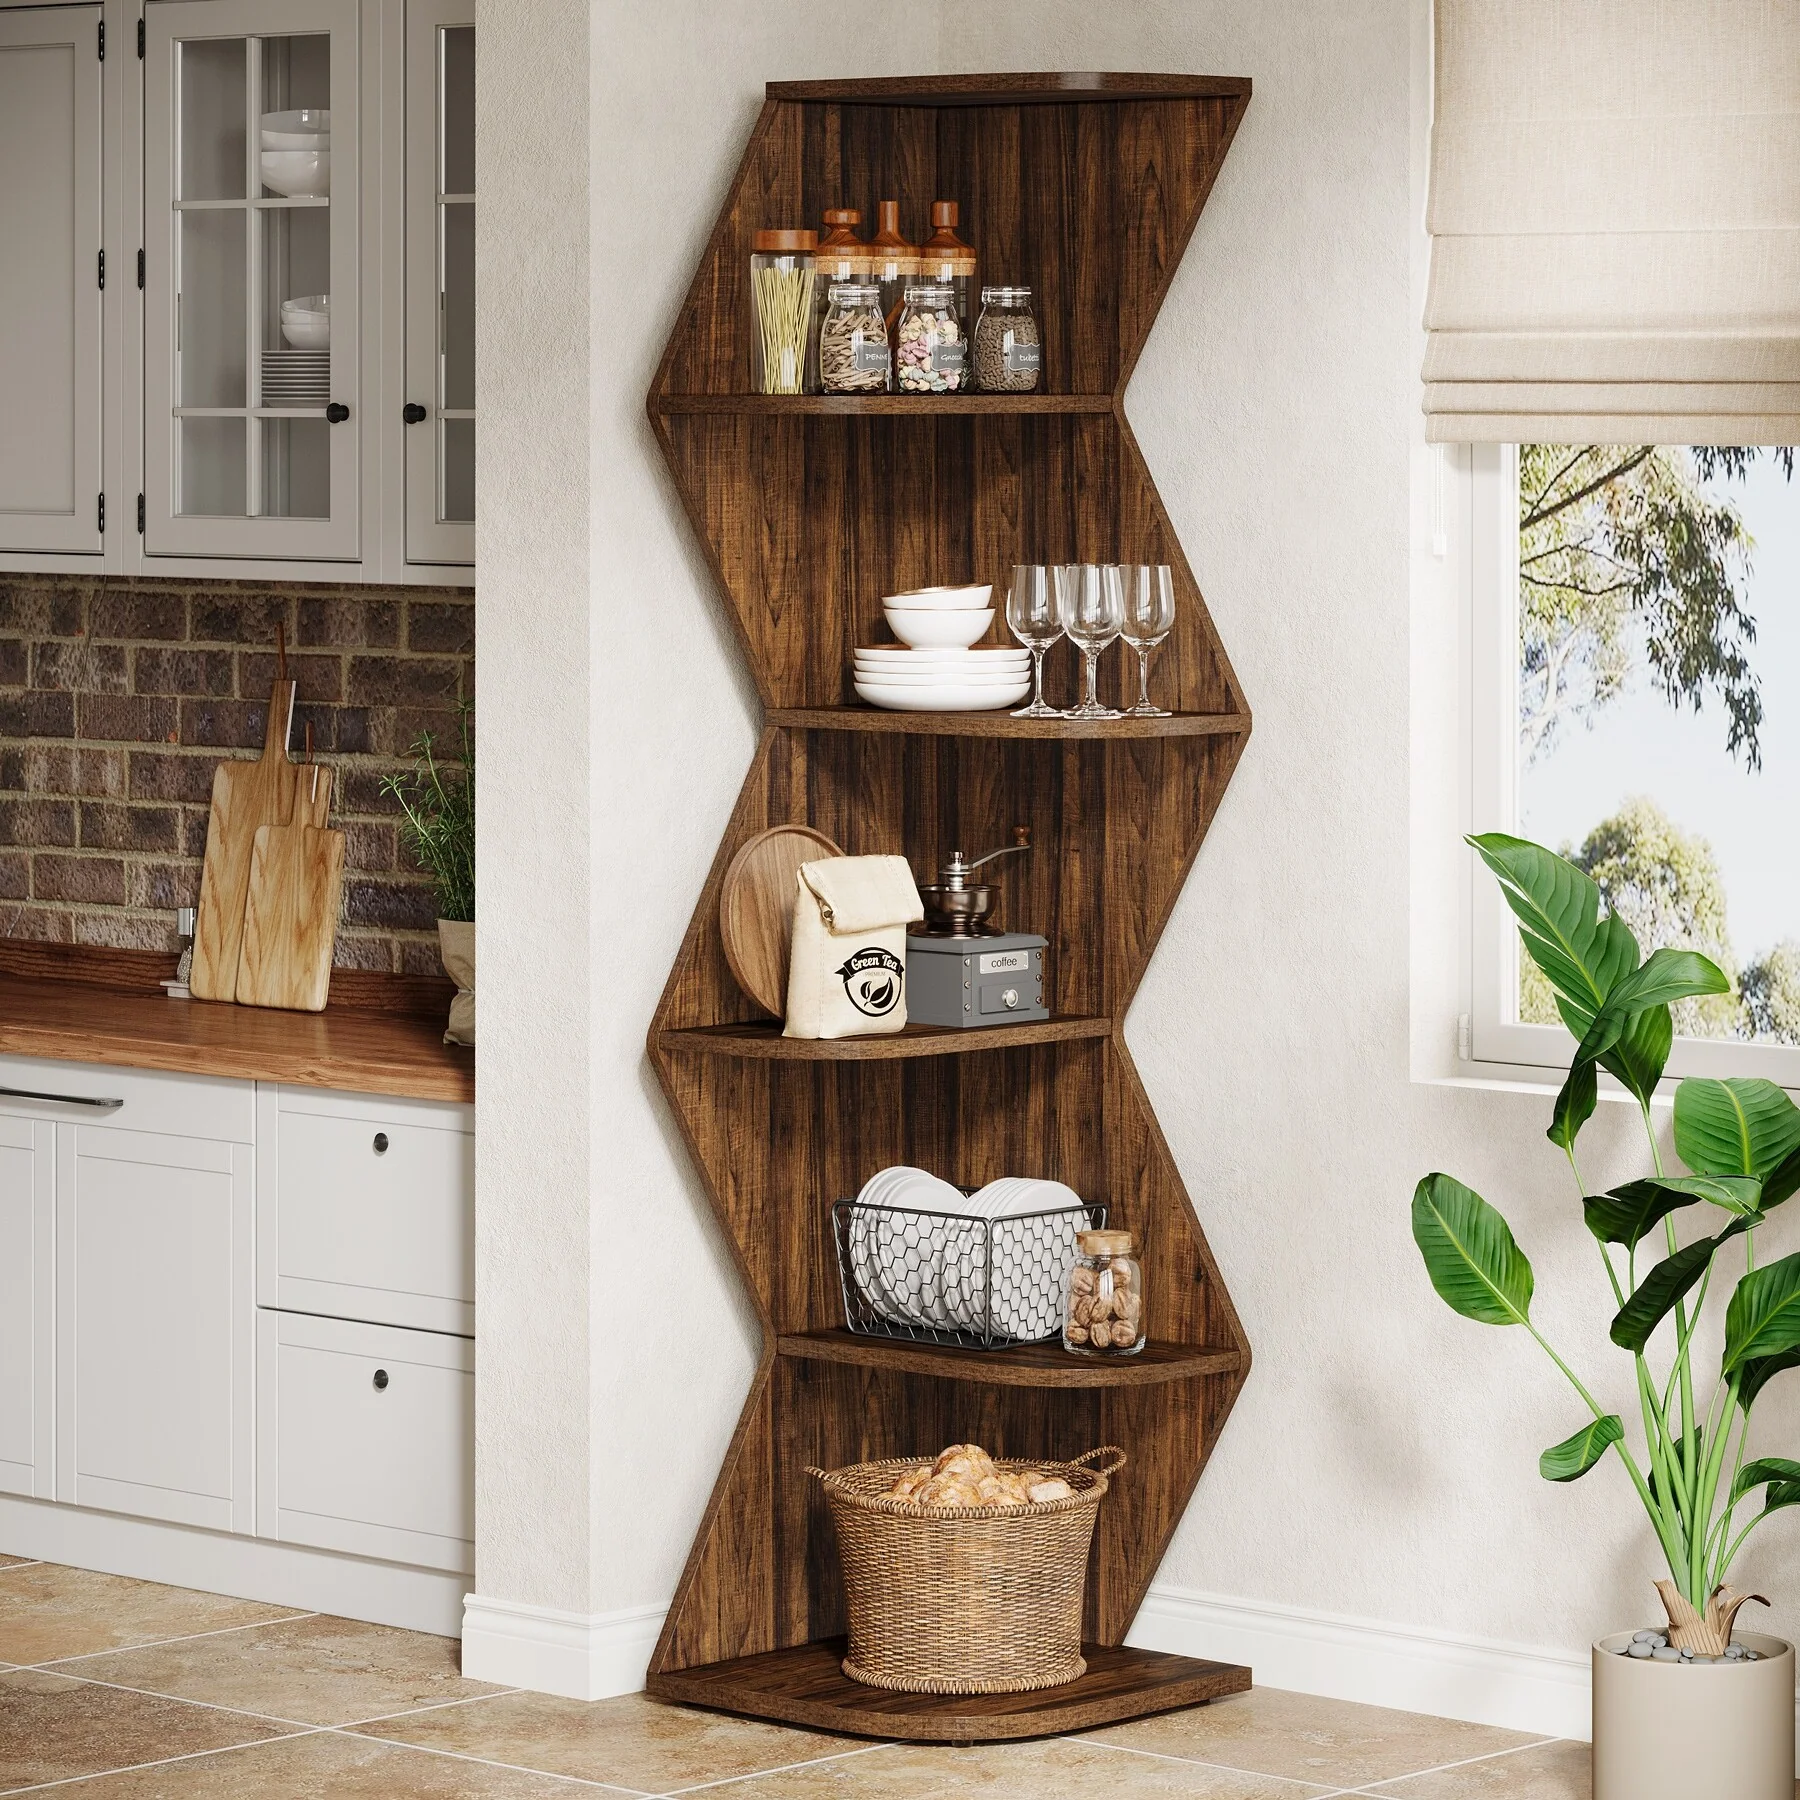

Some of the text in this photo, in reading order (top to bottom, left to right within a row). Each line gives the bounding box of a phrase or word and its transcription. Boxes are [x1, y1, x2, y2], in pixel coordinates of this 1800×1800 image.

[851, 954, 898, 971] Green Tea
[991, 956, 1018, 968] coffee
